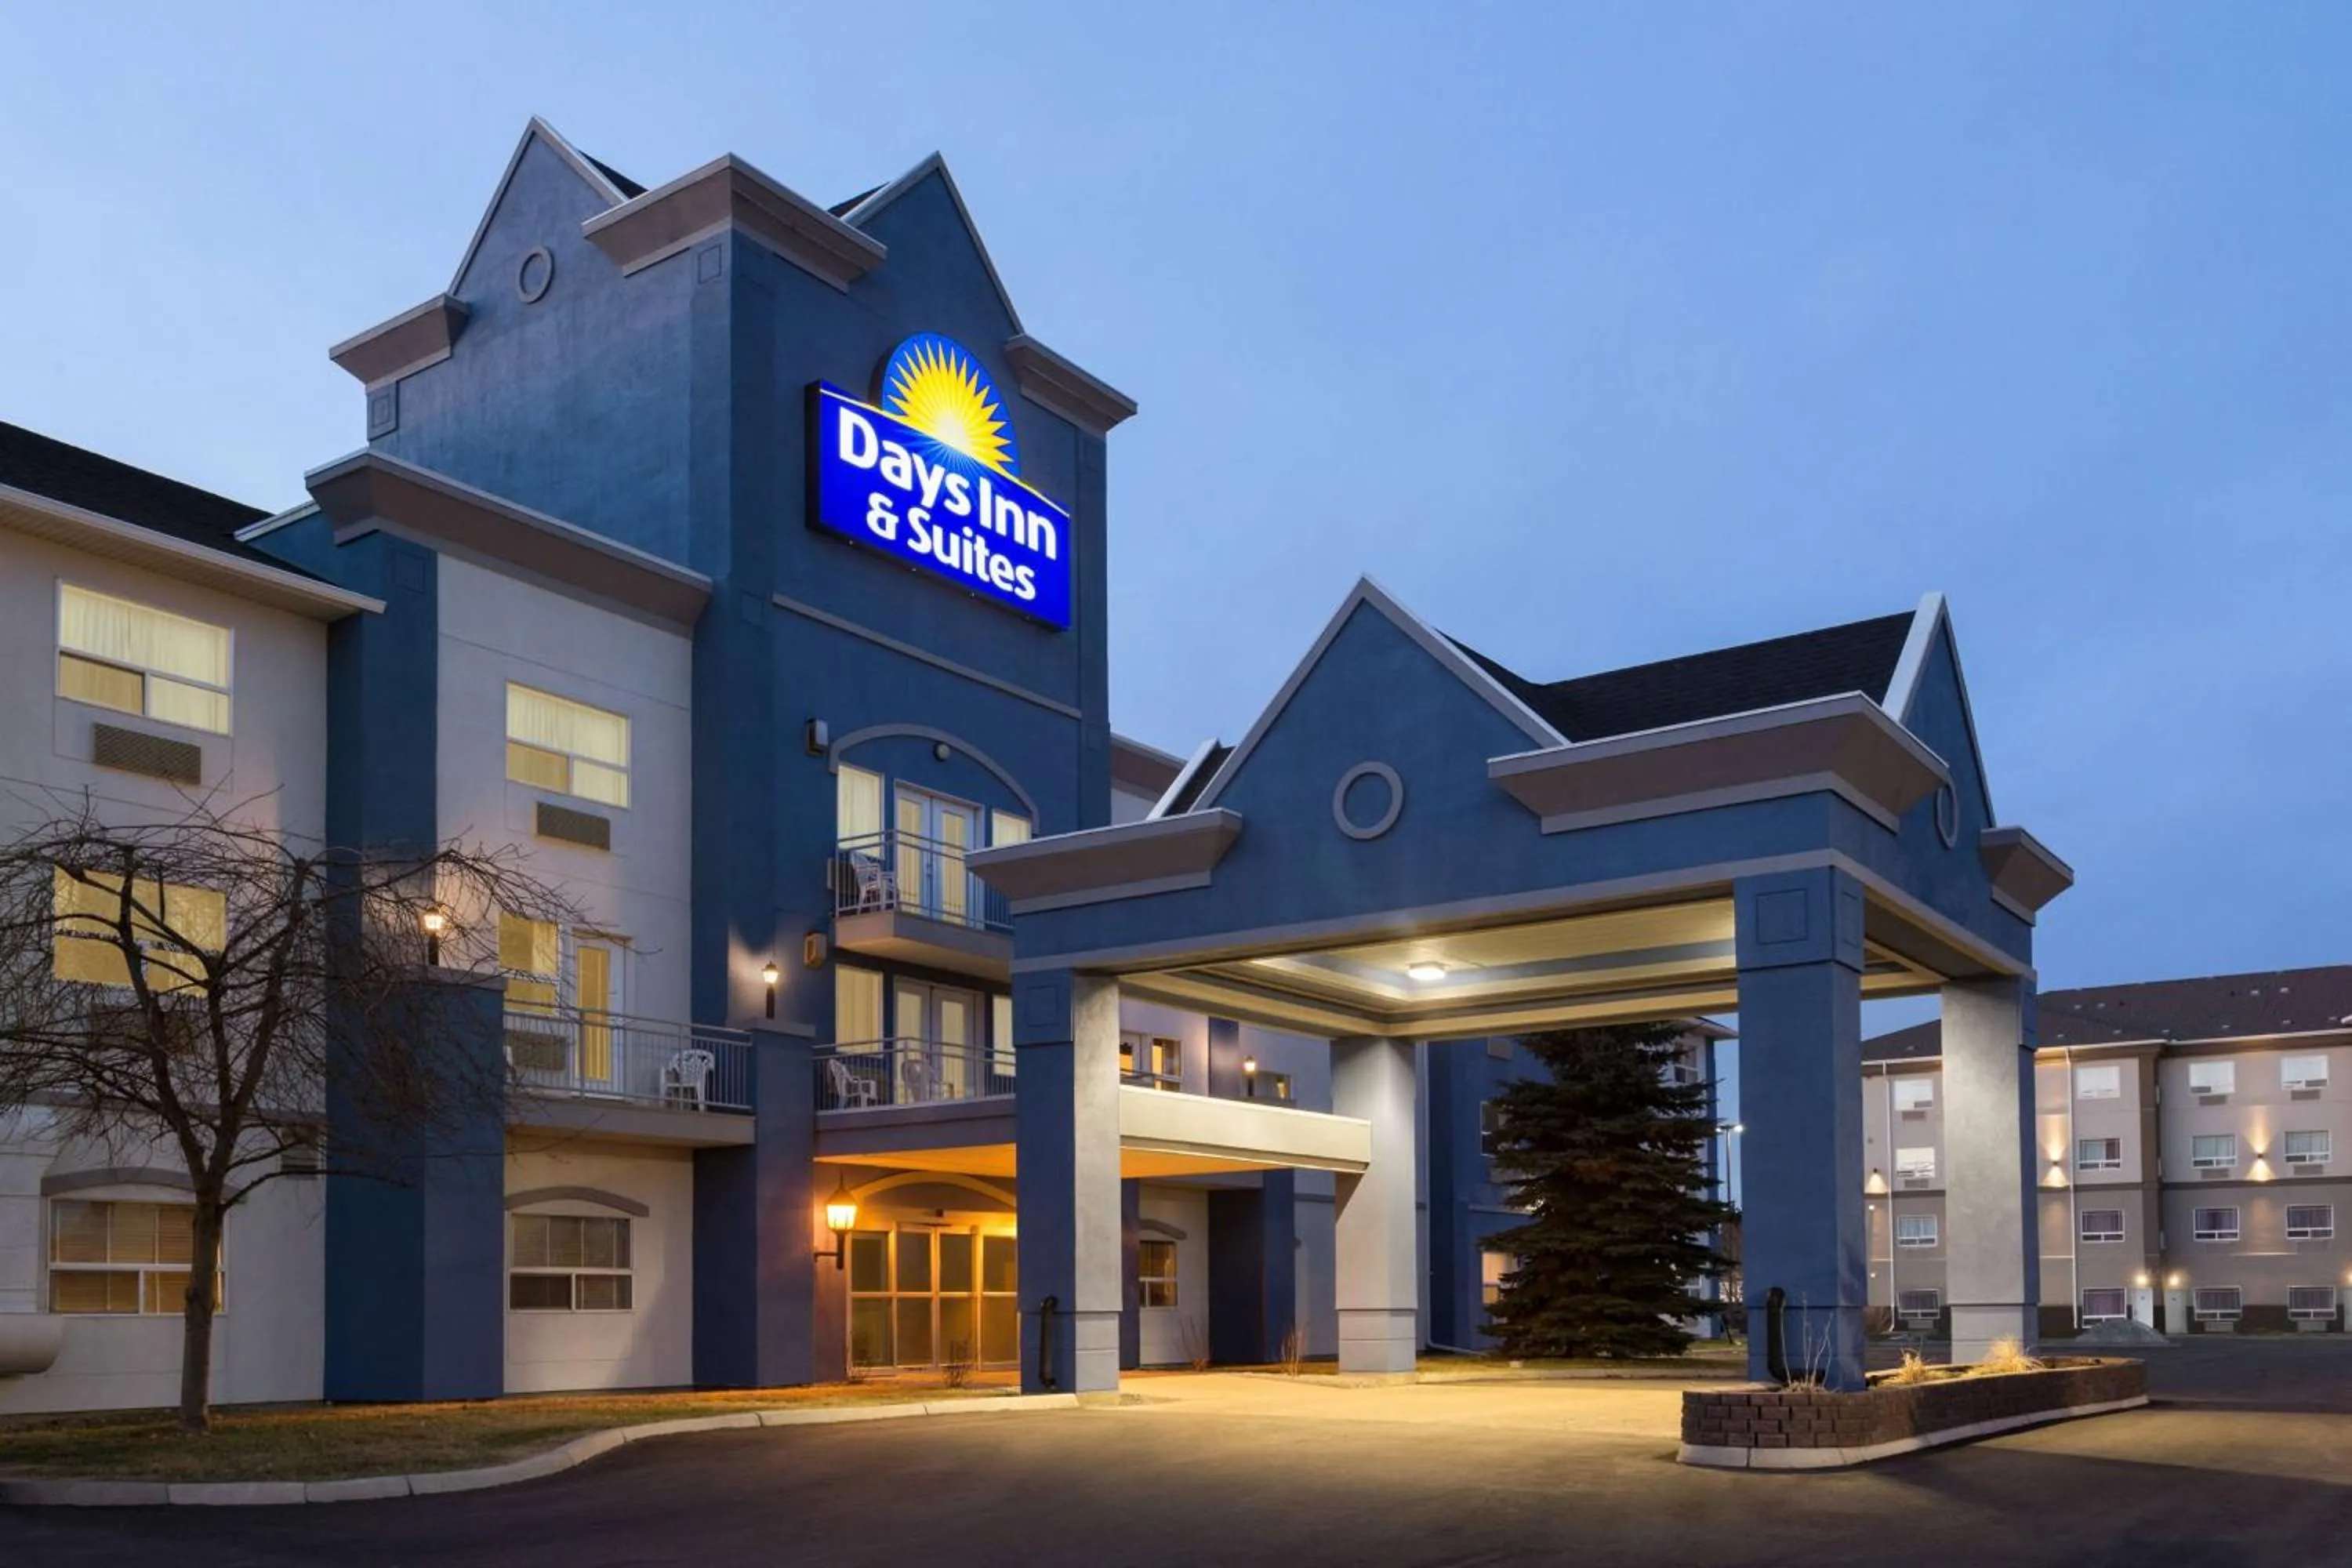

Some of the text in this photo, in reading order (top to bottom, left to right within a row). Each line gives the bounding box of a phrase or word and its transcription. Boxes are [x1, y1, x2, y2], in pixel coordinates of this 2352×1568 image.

[839, 406, 1057, 560] Days Inn
[866, 492, 1036, 600] & Suites
